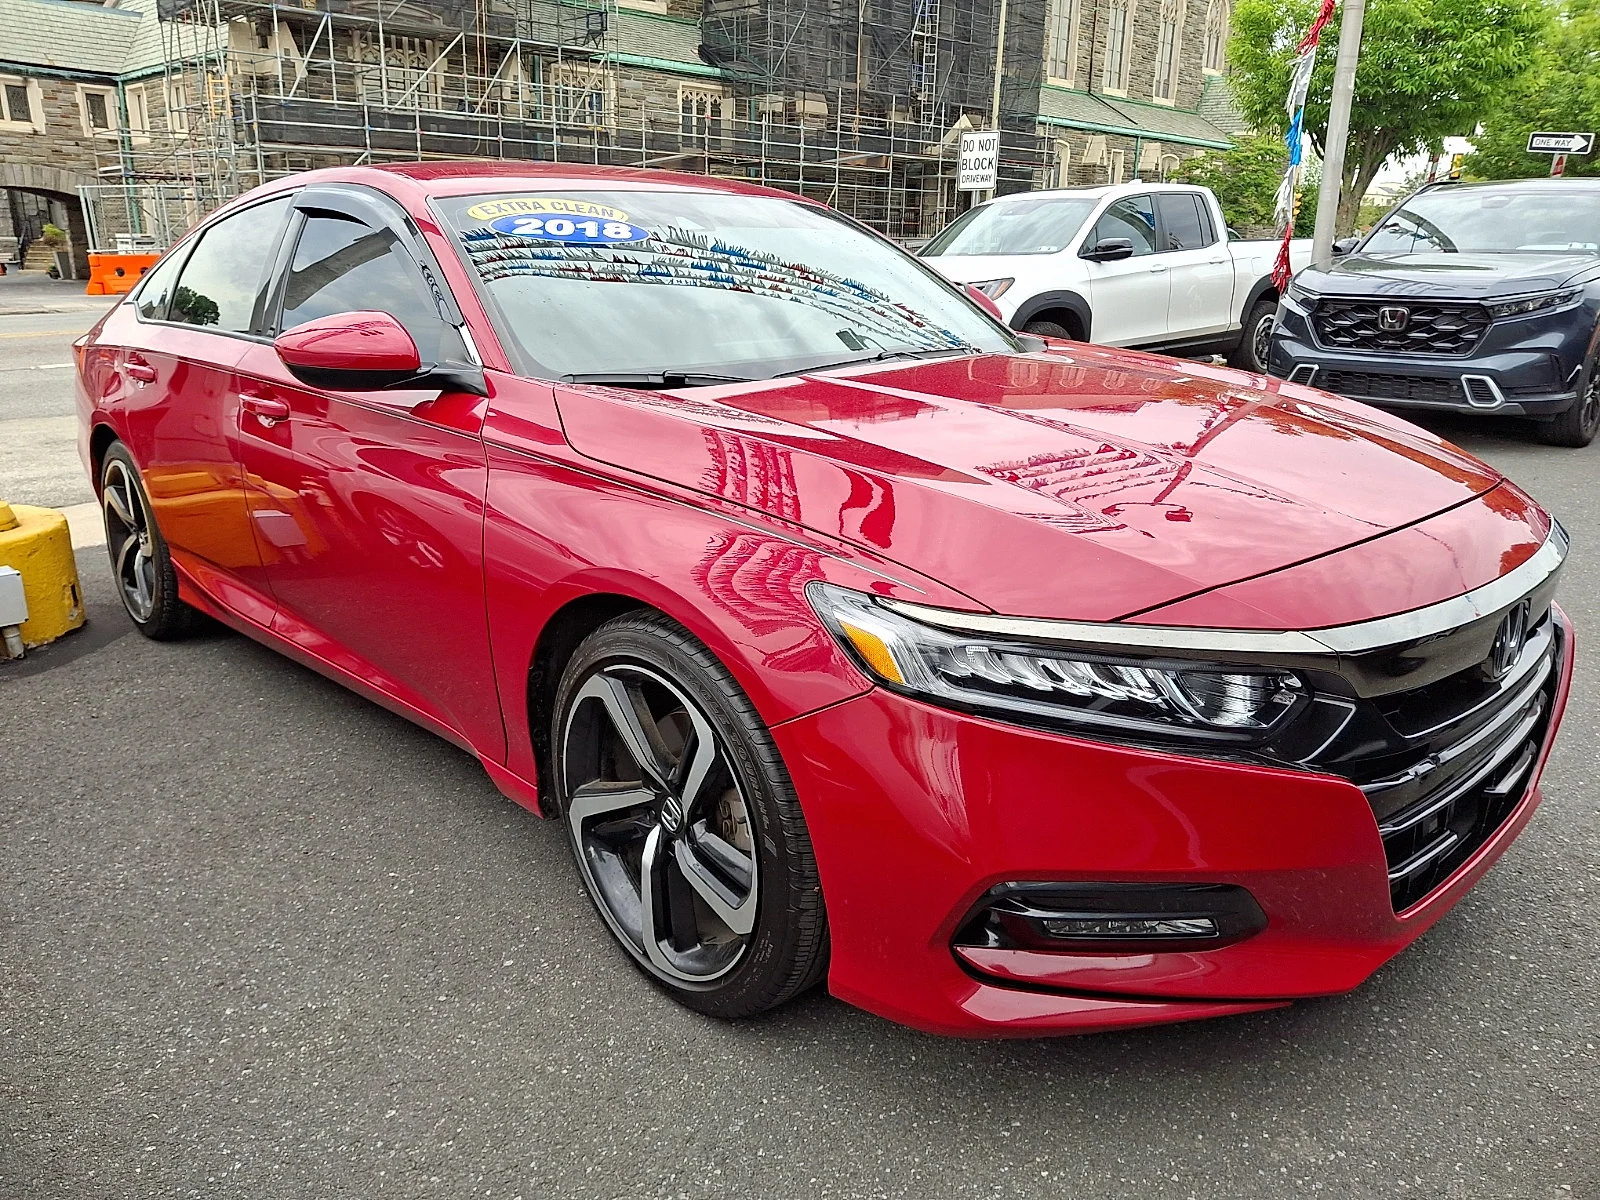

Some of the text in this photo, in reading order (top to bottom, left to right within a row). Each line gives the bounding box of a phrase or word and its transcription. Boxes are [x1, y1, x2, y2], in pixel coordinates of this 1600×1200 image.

[962, 138, 997, 152] DO NOT
[1534, 138, 1572, 147] ONE WAY
[961, 157, 995, 171] BLOCK
[961, 173, 992, 184] DRIVEWAY
[479, 201, 615, 218] EXTRA CLEAN
[511, 217, 633, 239] 2018
